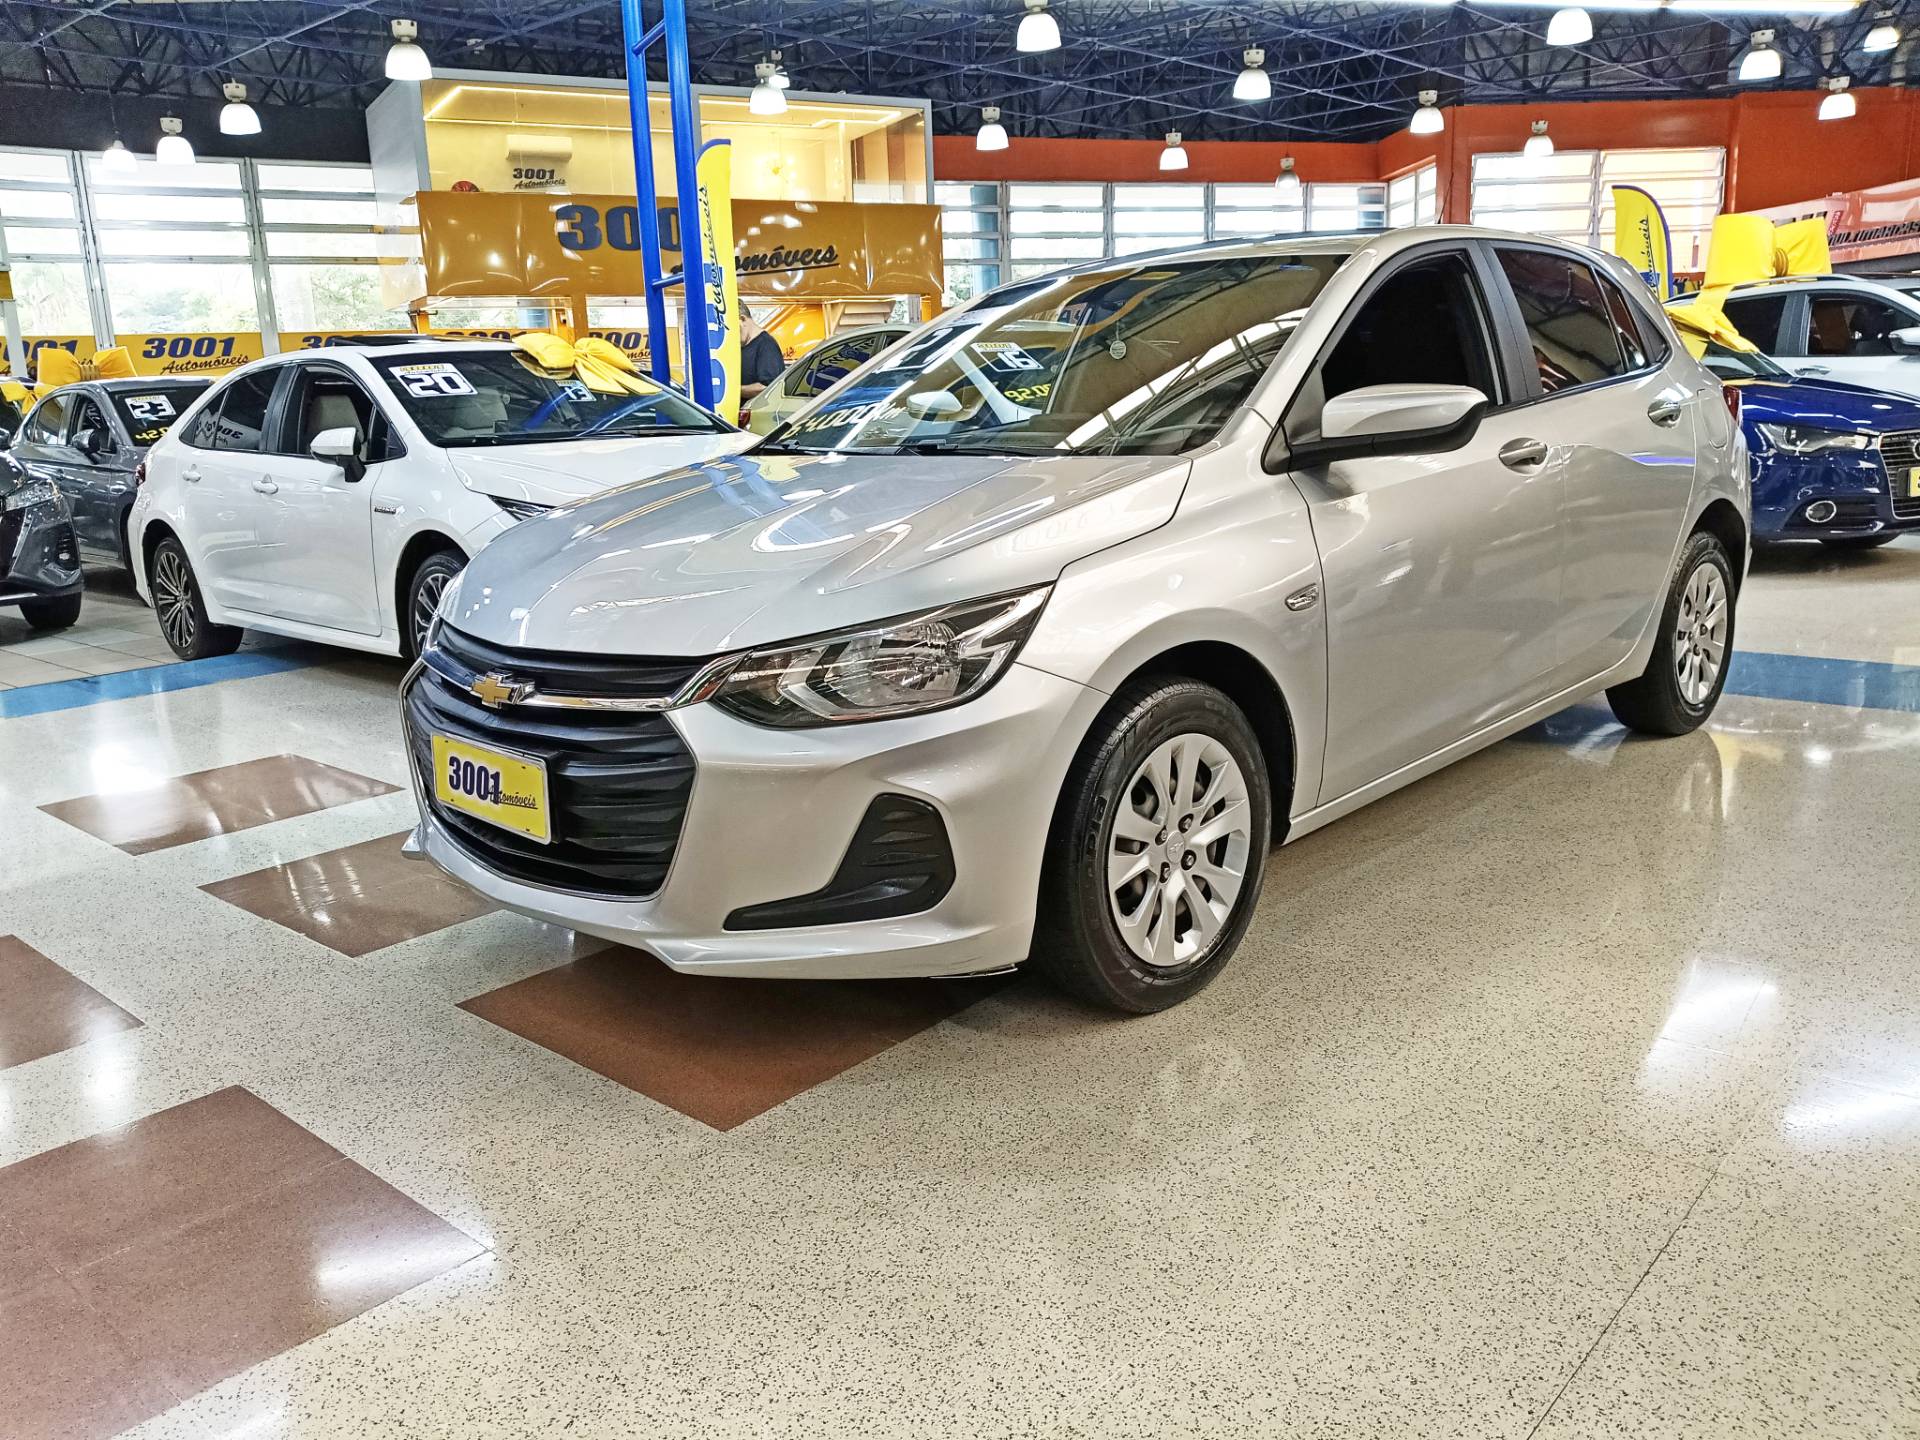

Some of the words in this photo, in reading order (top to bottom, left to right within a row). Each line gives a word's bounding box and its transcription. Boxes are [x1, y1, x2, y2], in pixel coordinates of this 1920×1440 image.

[513, 168, 555, 180] 3001
[513, 178, 566, 190] Automóveis
[142, 337, 235, 358] 3001
[161, 354, 249, 374] Automóveis
[997, 351, 1040, 369] 16
[404, 373, 472, 396] 20
[131, 401, 170, 418] 23
[448, 755, 500, 805] 3001
